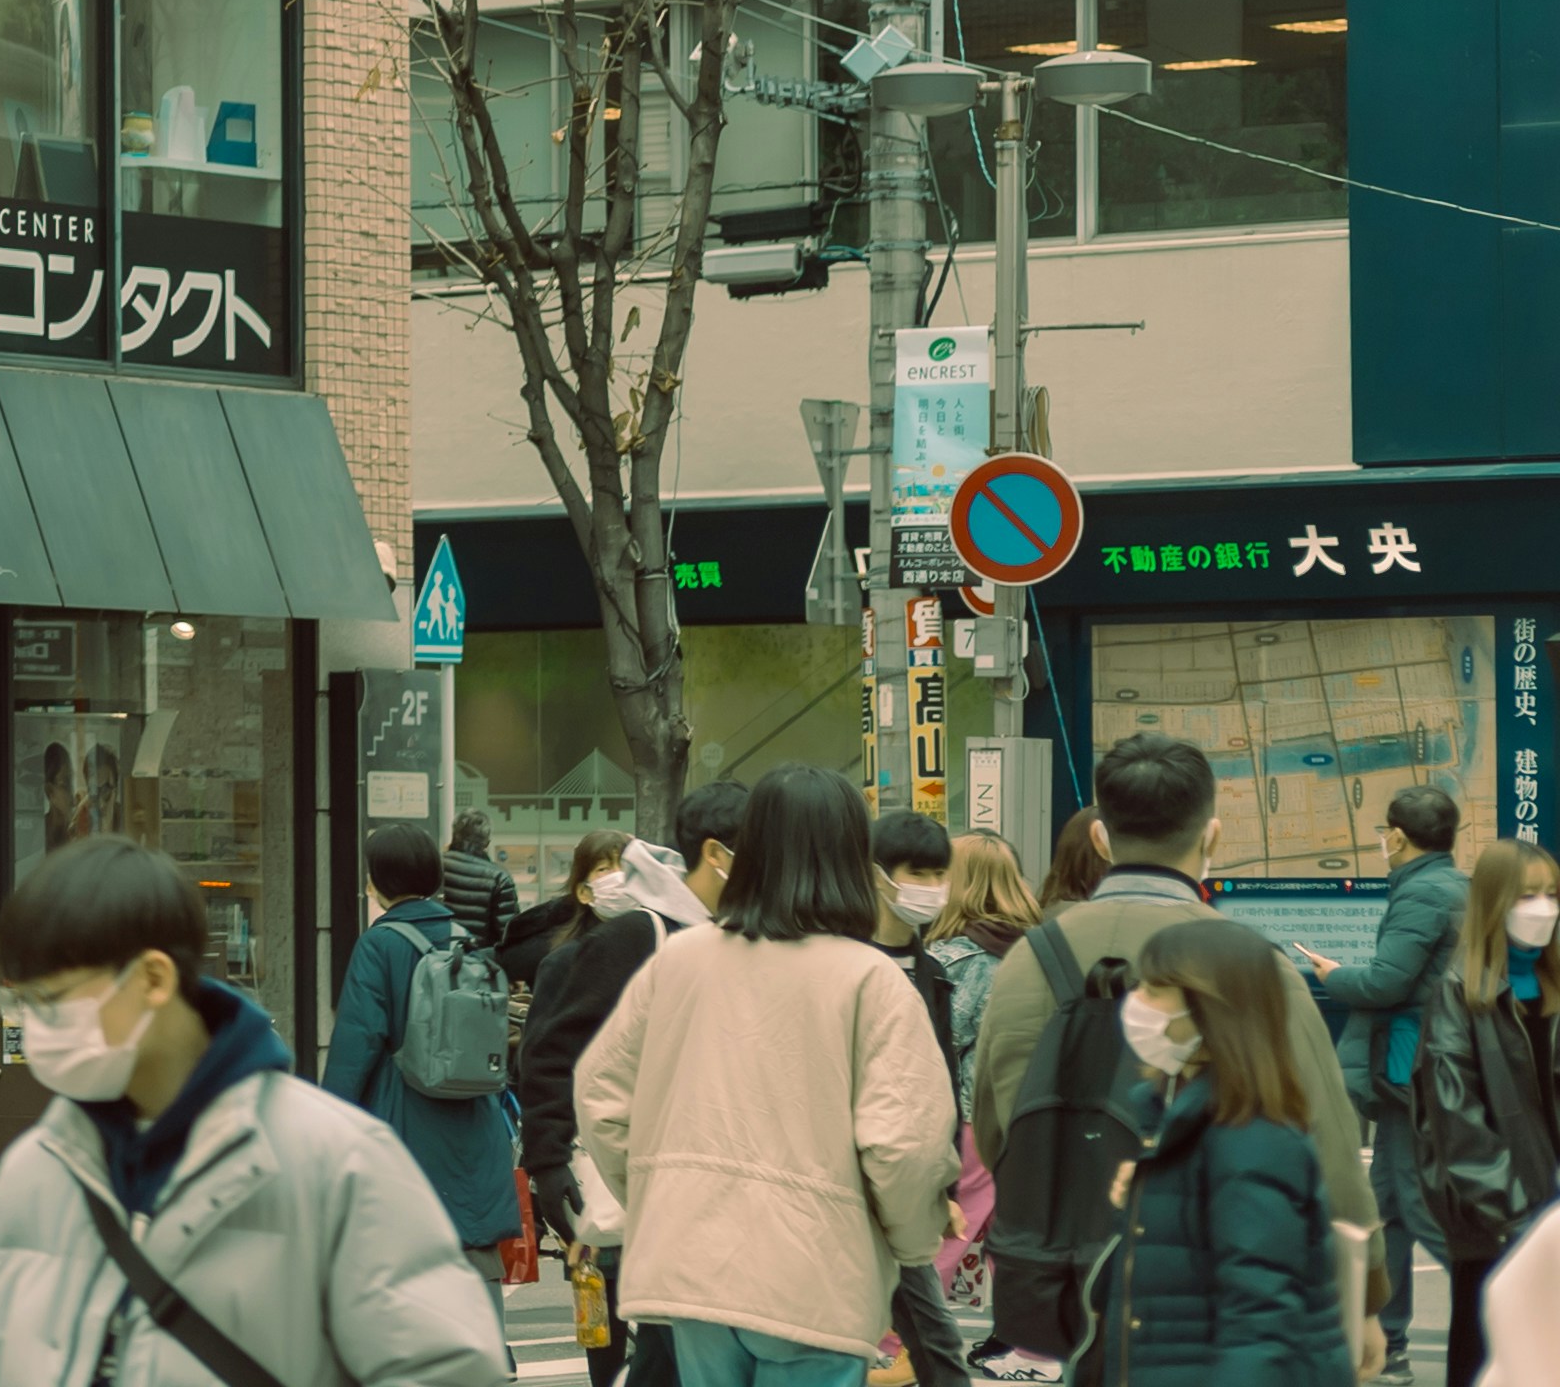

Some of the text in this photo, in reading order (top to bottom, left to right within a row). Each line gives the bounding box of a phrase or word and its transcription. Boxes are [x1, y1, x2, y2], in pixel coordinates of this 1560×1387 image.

[674, 561, 723, 590] 売買
[1101, 540, 1272, 575] 不動産の銀行
[1513, 617, 1538, 726] 街の歴史、
[400, 690, 429, 727] 2F
